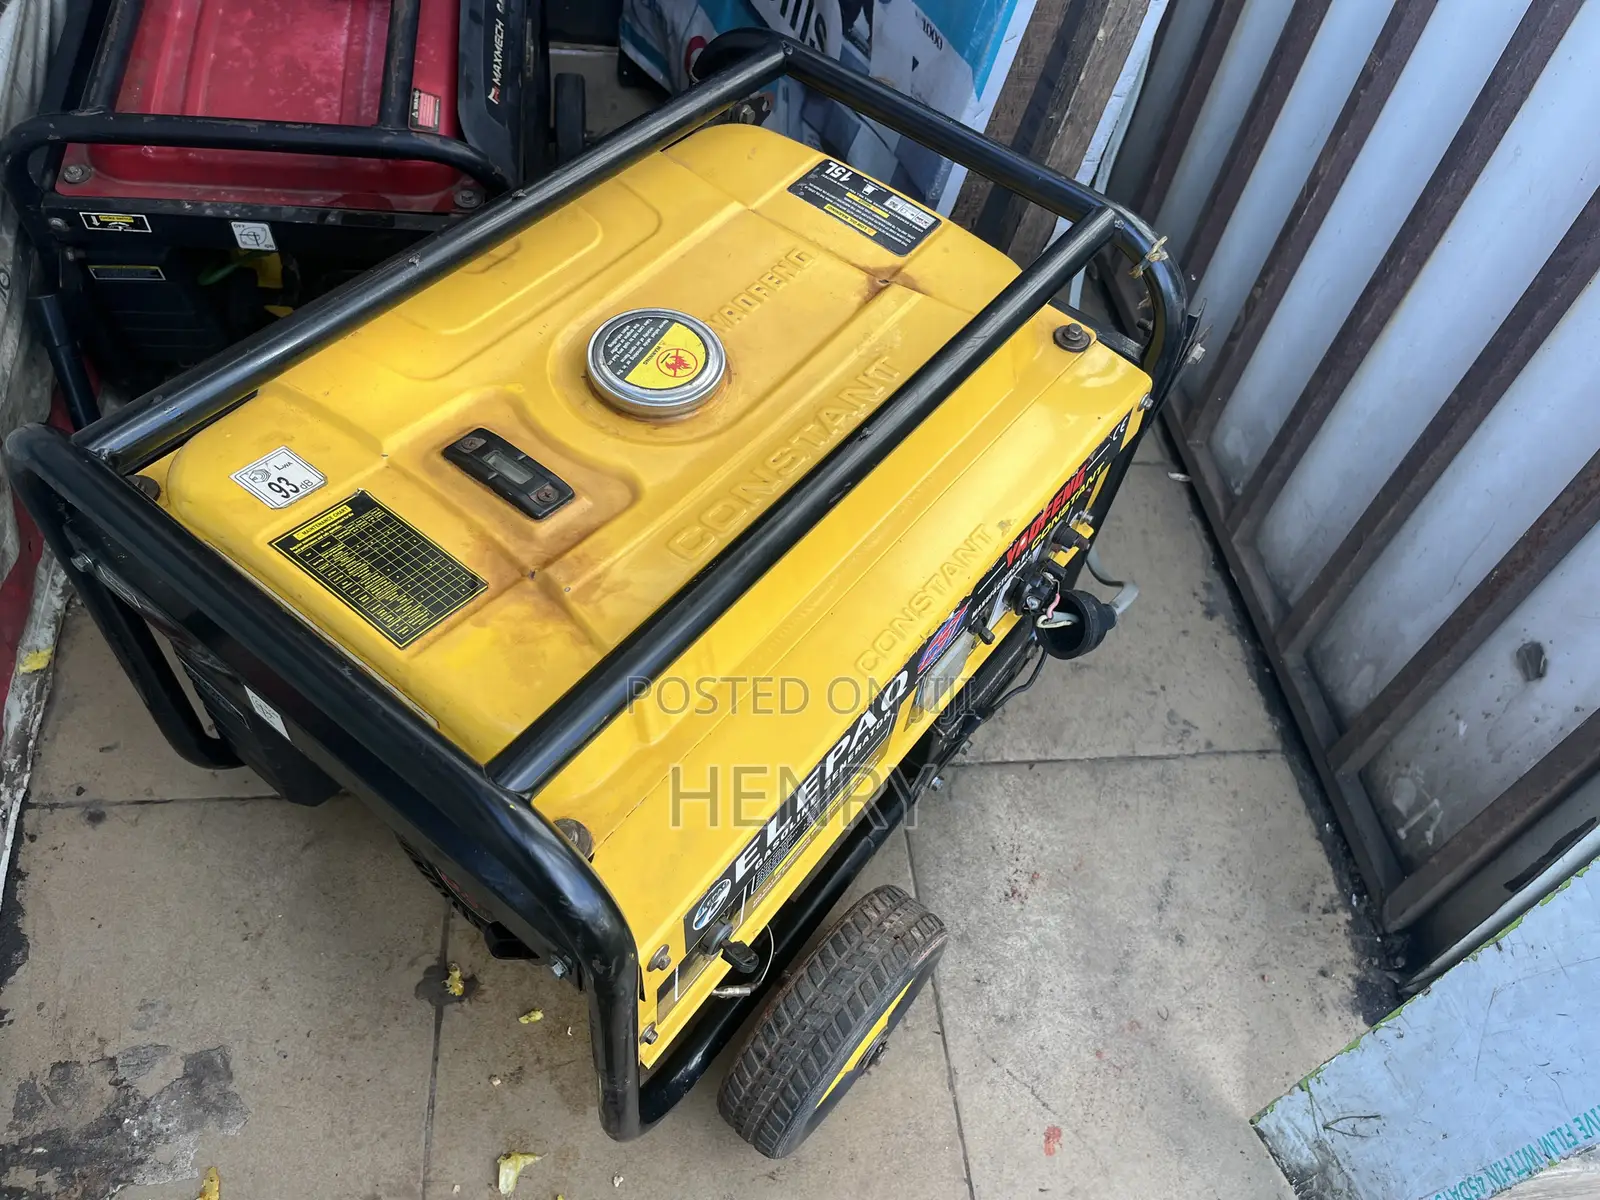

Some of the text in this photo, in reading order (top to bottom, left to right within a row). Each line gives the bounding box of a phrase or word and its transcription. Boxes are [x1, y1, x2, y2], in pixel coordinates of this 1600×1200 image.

[492, 18, 505, 86] MAXMECH
[824, 162, 854, 181] 15L
[267, 476, 313, 498] 93 dB
[666, 356, 901, 561] CONSTANT
[301, 506, 348, 535] MAINTENANCE CHART
[1031, 459, 1107, 552] CONSTANT
[856, 523, 993, 676] CONSTANT
[735, 670, 909, 883] ELEPAQ
[755, 795, 819, 872] GASOLINE
[823, 712, 894, 790] GENERATOR
[1485, 1144, 1541, 1188] WITHIN
[1536, 1122, 1578, 1160] FILM
